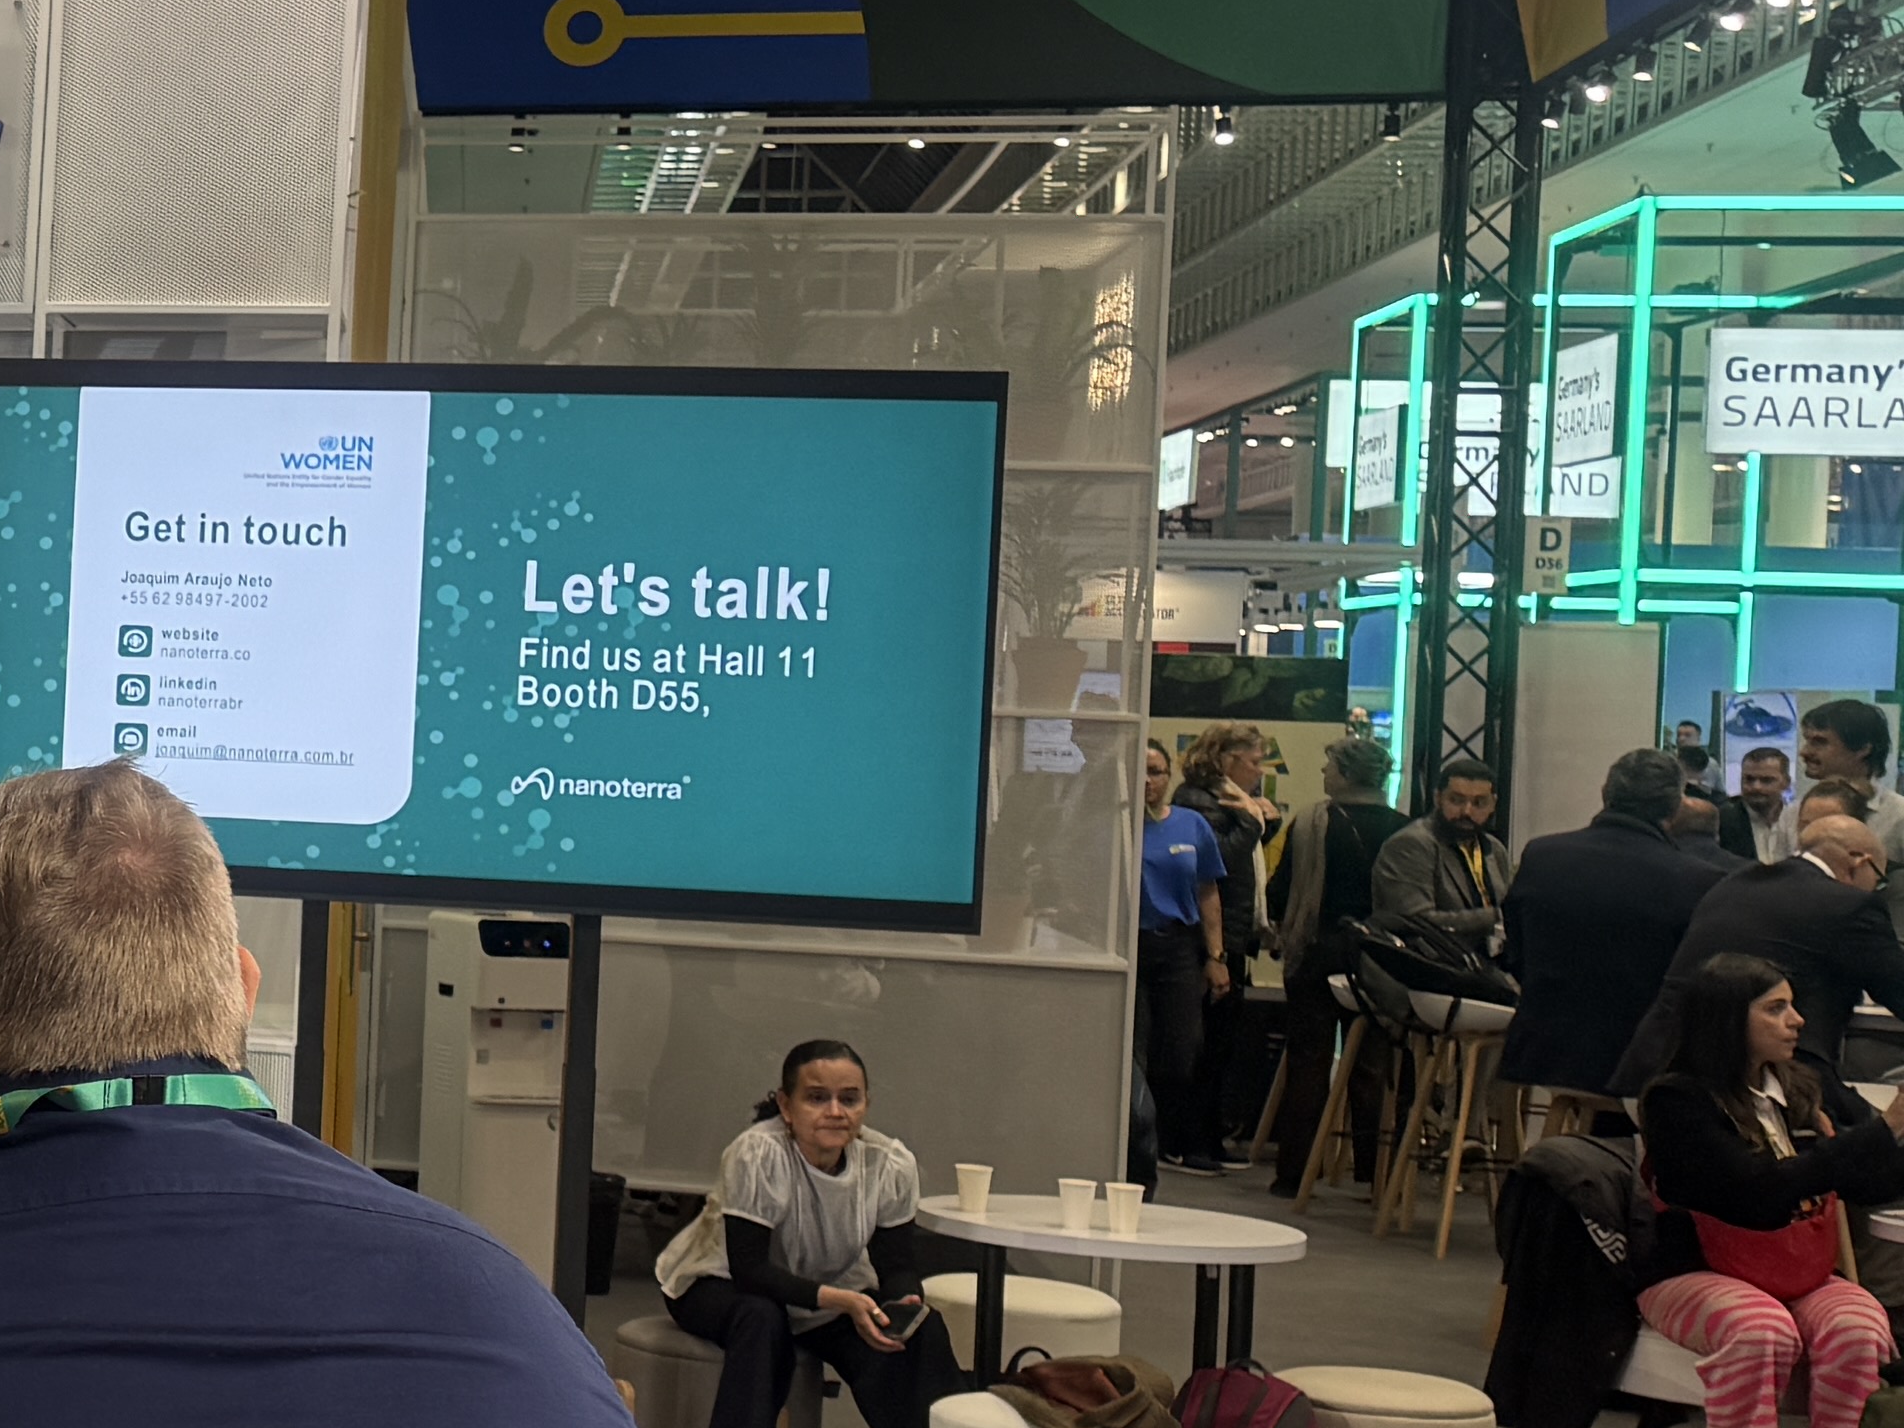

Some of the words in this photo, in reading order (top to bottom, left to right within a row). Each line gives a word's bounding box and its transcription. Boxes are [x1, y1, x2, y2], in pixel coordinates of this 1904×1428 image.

[1557, 368, 1600, 400] Germany's
[1555, 400, 1612, 442] SAARLAND
[340, 435, 374, 452] UN
[280, 453, 373, 471] WOMEN
[125, 510, 186, 543] Get
[198, 512, 229, 544] in
[243, 514, 347, 547] touch
[1540, 527, 1562, 552] D
[121, 570, 180, 588] Joaquim
[184, 571, 233, 589] Araujo
[238, 573, 273, 587] Neto
[121, 590, 148, 605] +55
[152, 591, 171, 606] 62
[175, 591, 269, 608] 98497-2002
[524, 559, 671, 617] Let's
[691, 565, 830, 621] talk!
[161, 627, 220, 642] website
[160, 645, 251, 662] nanoterra.co
[519, 637, 591, 670] Find
[603, 646, 641, 672] us
[653, 644, 686, 673] at
[699, 643, 764, 676] Hall
[778, 646, 816, 678] 11
[159, 675, 218, 691] linkedin
[158, 694, 244, 711] nanoterrabr
[517, 674, 618, 710] Booth
[633, 679, 710, 718] D55,
[156, 725, 197, 739] email
[155, 744, 355, 766] joaquim@nanoterra.com.br
[559, 776, 682, 800] nanoterra
